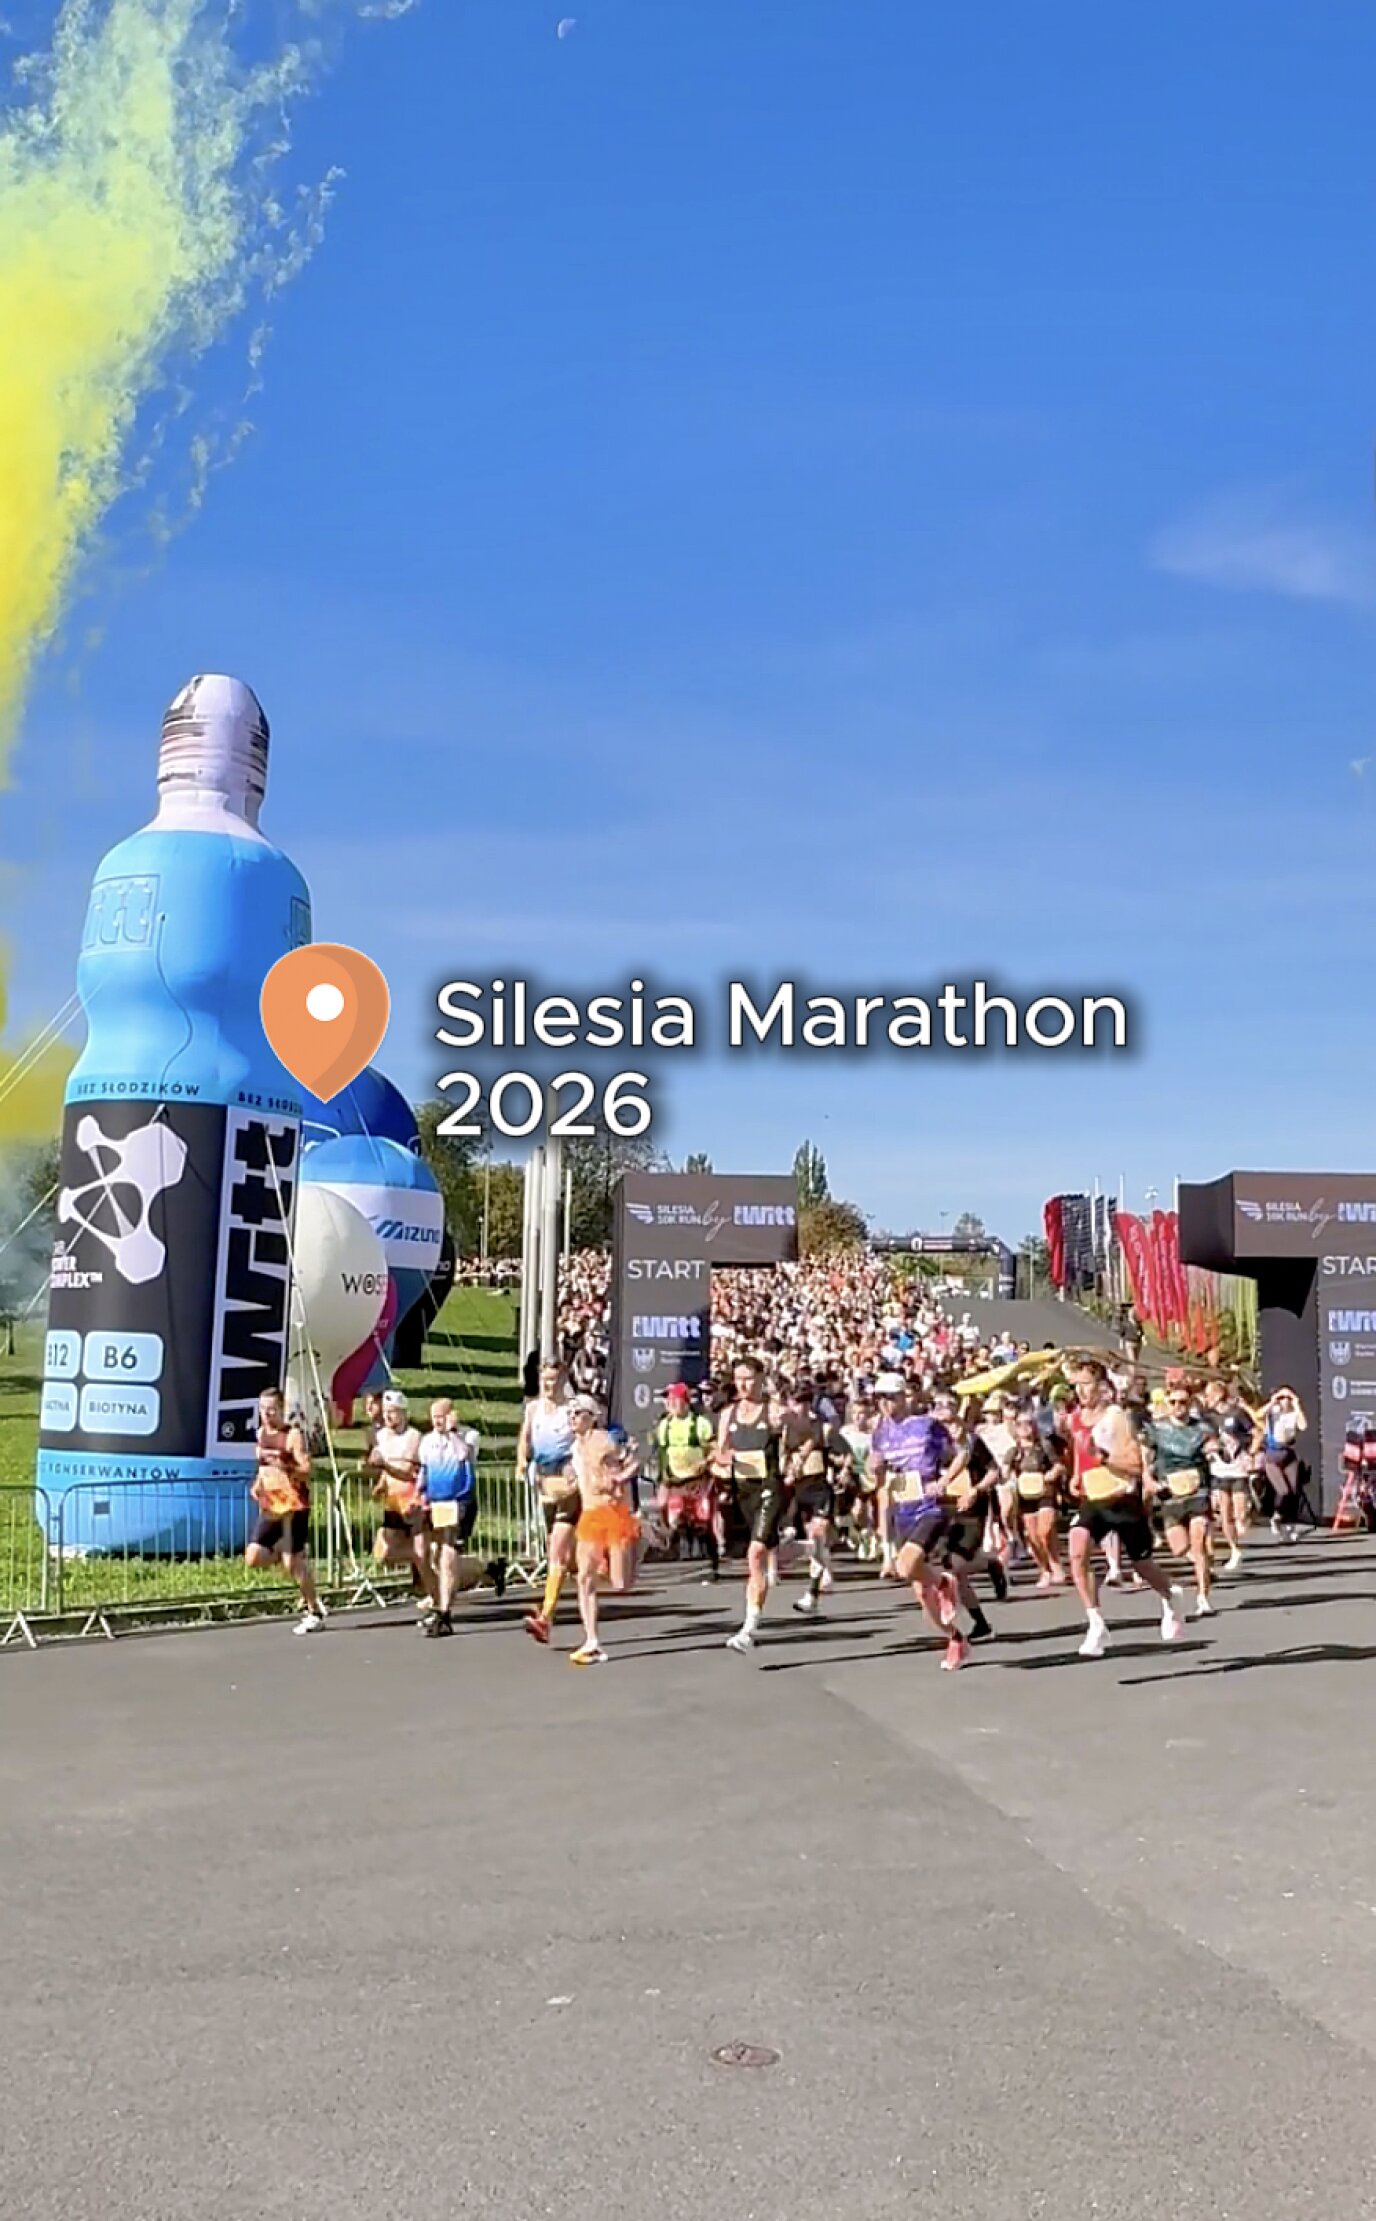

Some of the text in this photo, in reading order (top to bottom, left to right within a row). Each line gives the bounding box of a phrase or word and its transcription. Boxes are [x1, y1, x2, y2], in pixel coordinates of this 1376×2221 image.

[627, 1259, 705, 1280] START
[103, 1345, 138, 1369] B6
[88, 1401, 148, 1415] BIOTYNA
